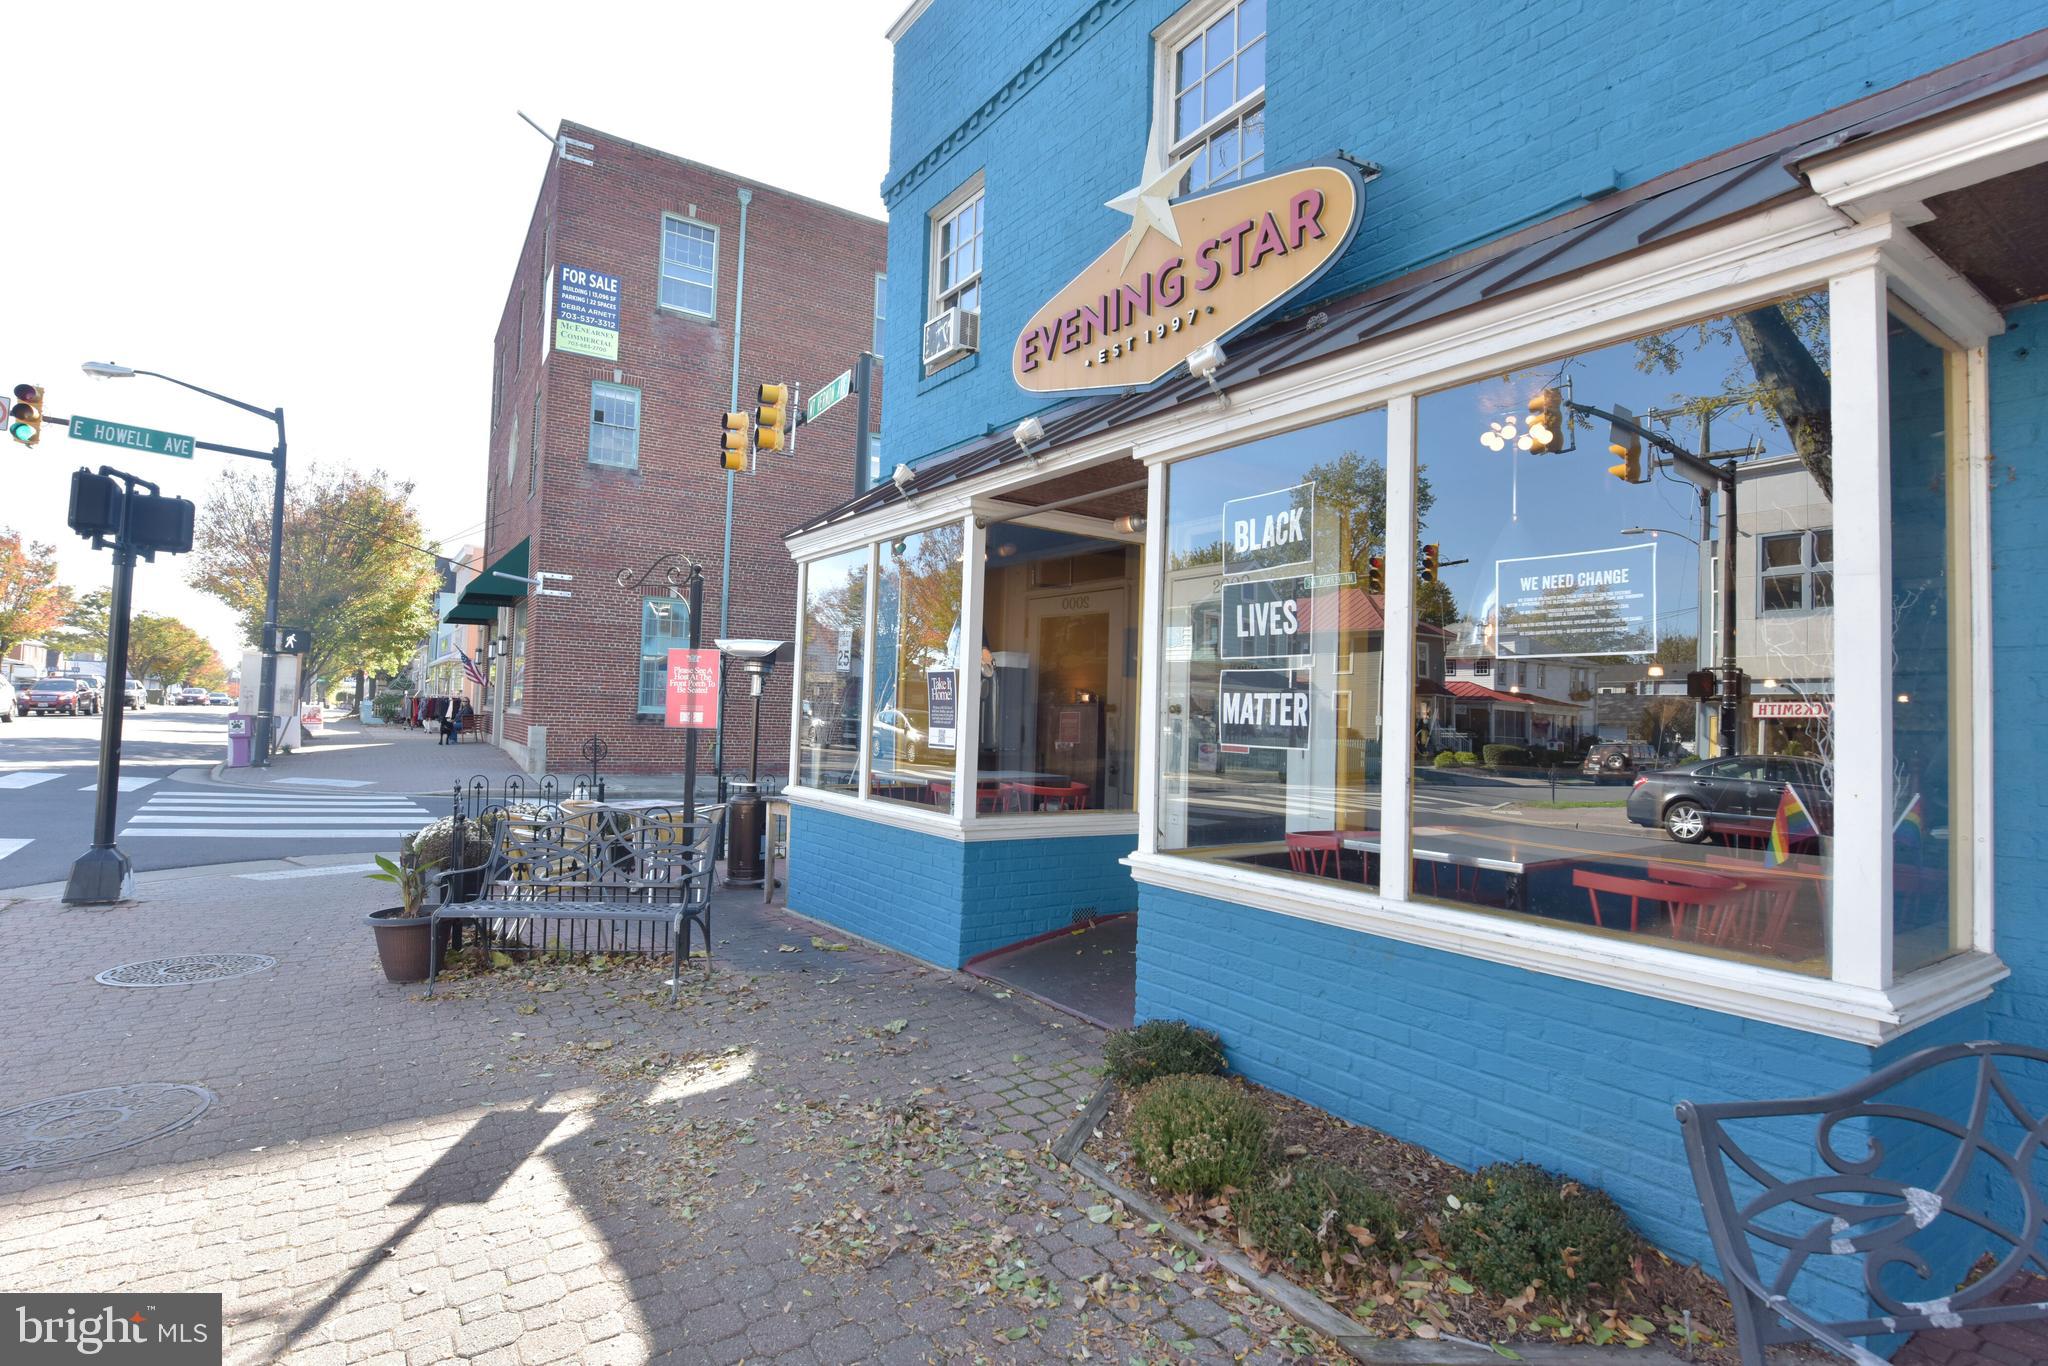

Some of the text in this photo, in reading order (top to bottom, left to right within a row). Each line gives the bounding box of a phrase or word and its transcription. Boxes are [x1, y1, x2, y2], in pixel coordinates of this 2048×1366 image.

[562, 267, 618, 292] FOR SALE
[562, 284, 588, 295] BUILDING
[1020, 188, 1327, 373] EVENING STAR
[561, 302, 616, 319] DEBRA ARNETT
[562, 292, 586, 303] PARKING
[597, 300, 616, 310] SPACES
[561, 311, 616, 328] 703-537-3312
[560, 330, 611, 348] COMMERCIAL
[1098, 308, 1198, 364] EST 1997
[74, 420, 190, 455] E HOWELL AVE
[1234, 506, 1304, 554] BLACK
[1520, 568, 1629, 592] WE NEED CHANGE
[1236, 599, 1298, 638] LIVES
[838, 650, 849, 666] 25
[931, 677, 947, 689] Take
[932, 688, 952, 700] Home!
[1223, 692, 1308, 726] MATTER
